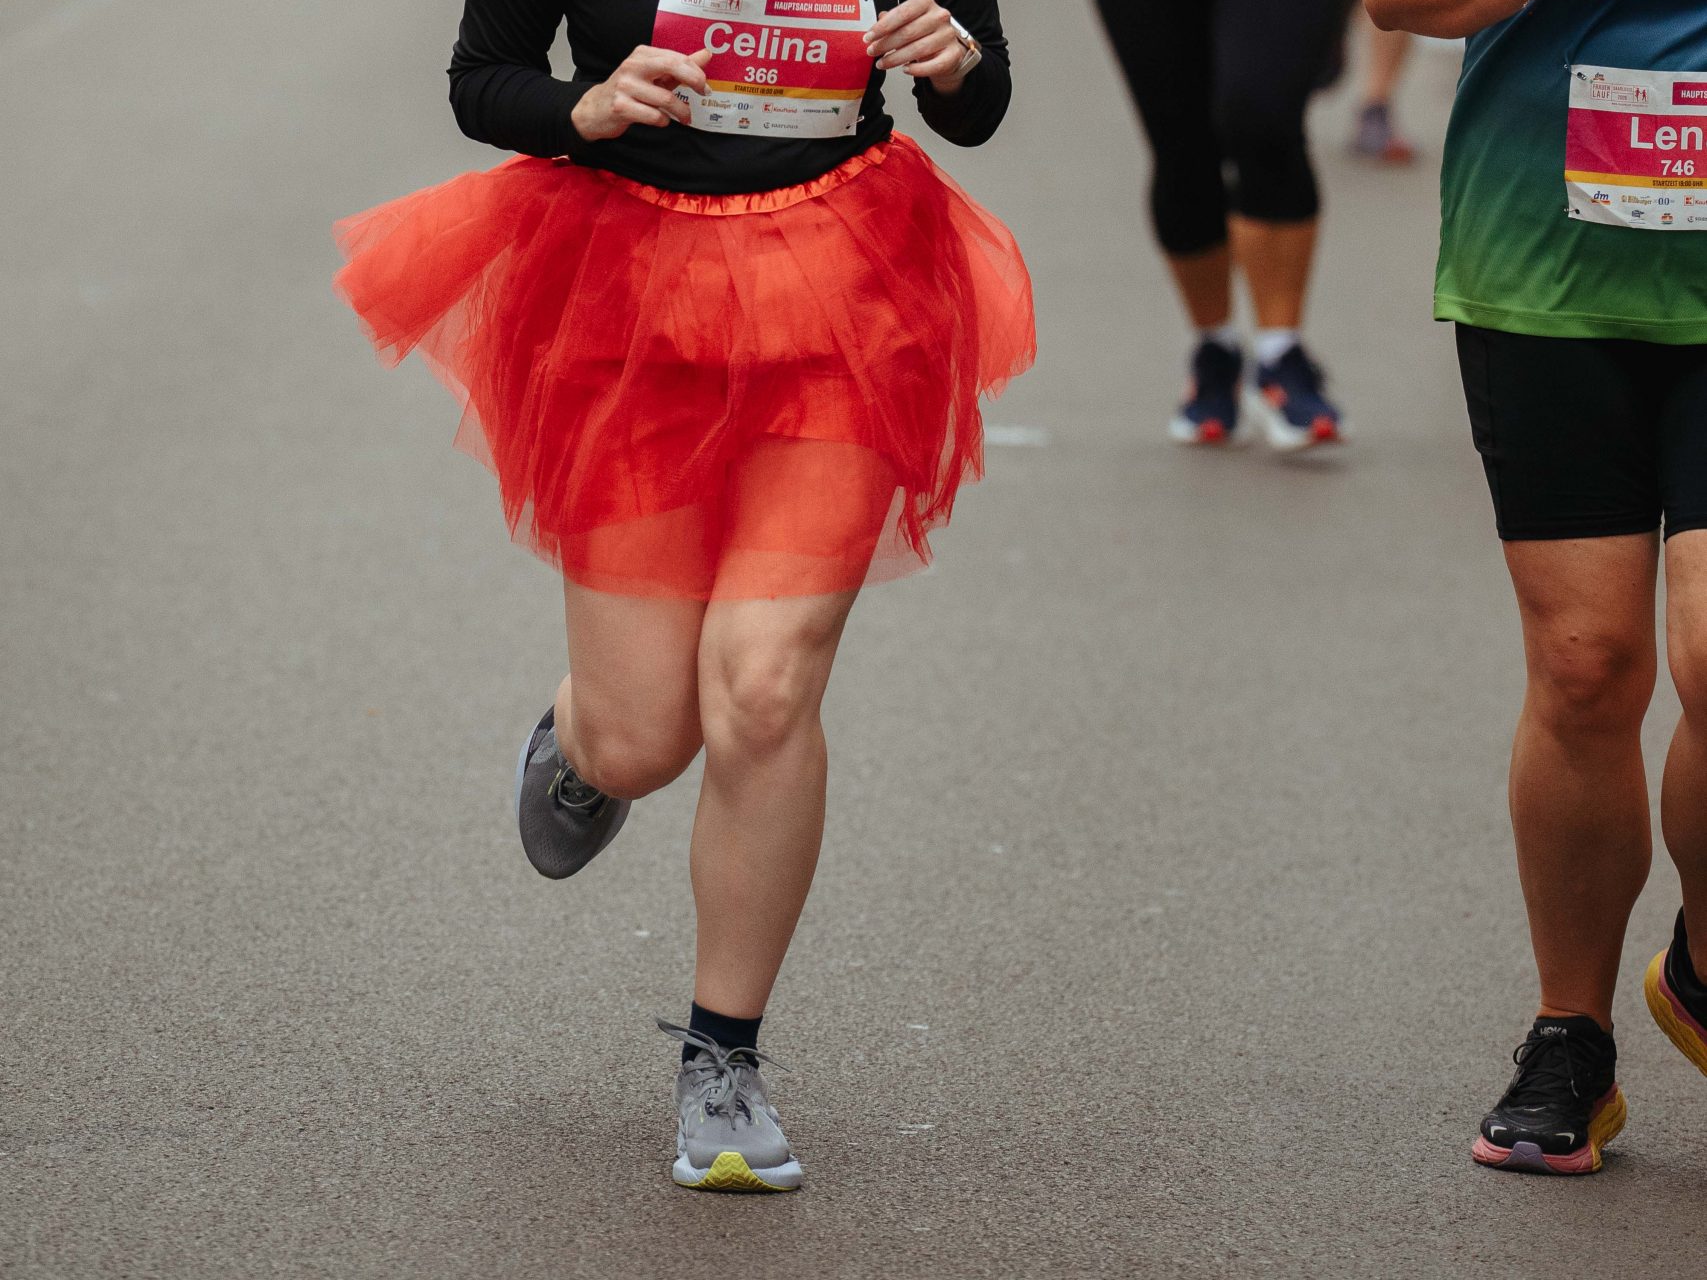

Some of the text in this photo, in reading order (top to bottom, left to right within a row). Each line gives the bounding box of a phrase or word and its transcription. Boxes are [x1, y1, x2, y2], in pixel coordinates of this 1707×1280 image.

[774, 1, 813, 13] HAUPTSACH
[704, 22, 829, 64] Celina
[744, 66, 778, 85] 366
[734, 84, 759, 94] STARTZEIT
[1592, 91, 1610, 99] LAUF
[1630, 116, 1707, 151] Len
[1661, 159, 1695, 176] 746
[1652, 179, 1678, 187] STARTZEIT
[1593, 190, 1609, 200] dm
